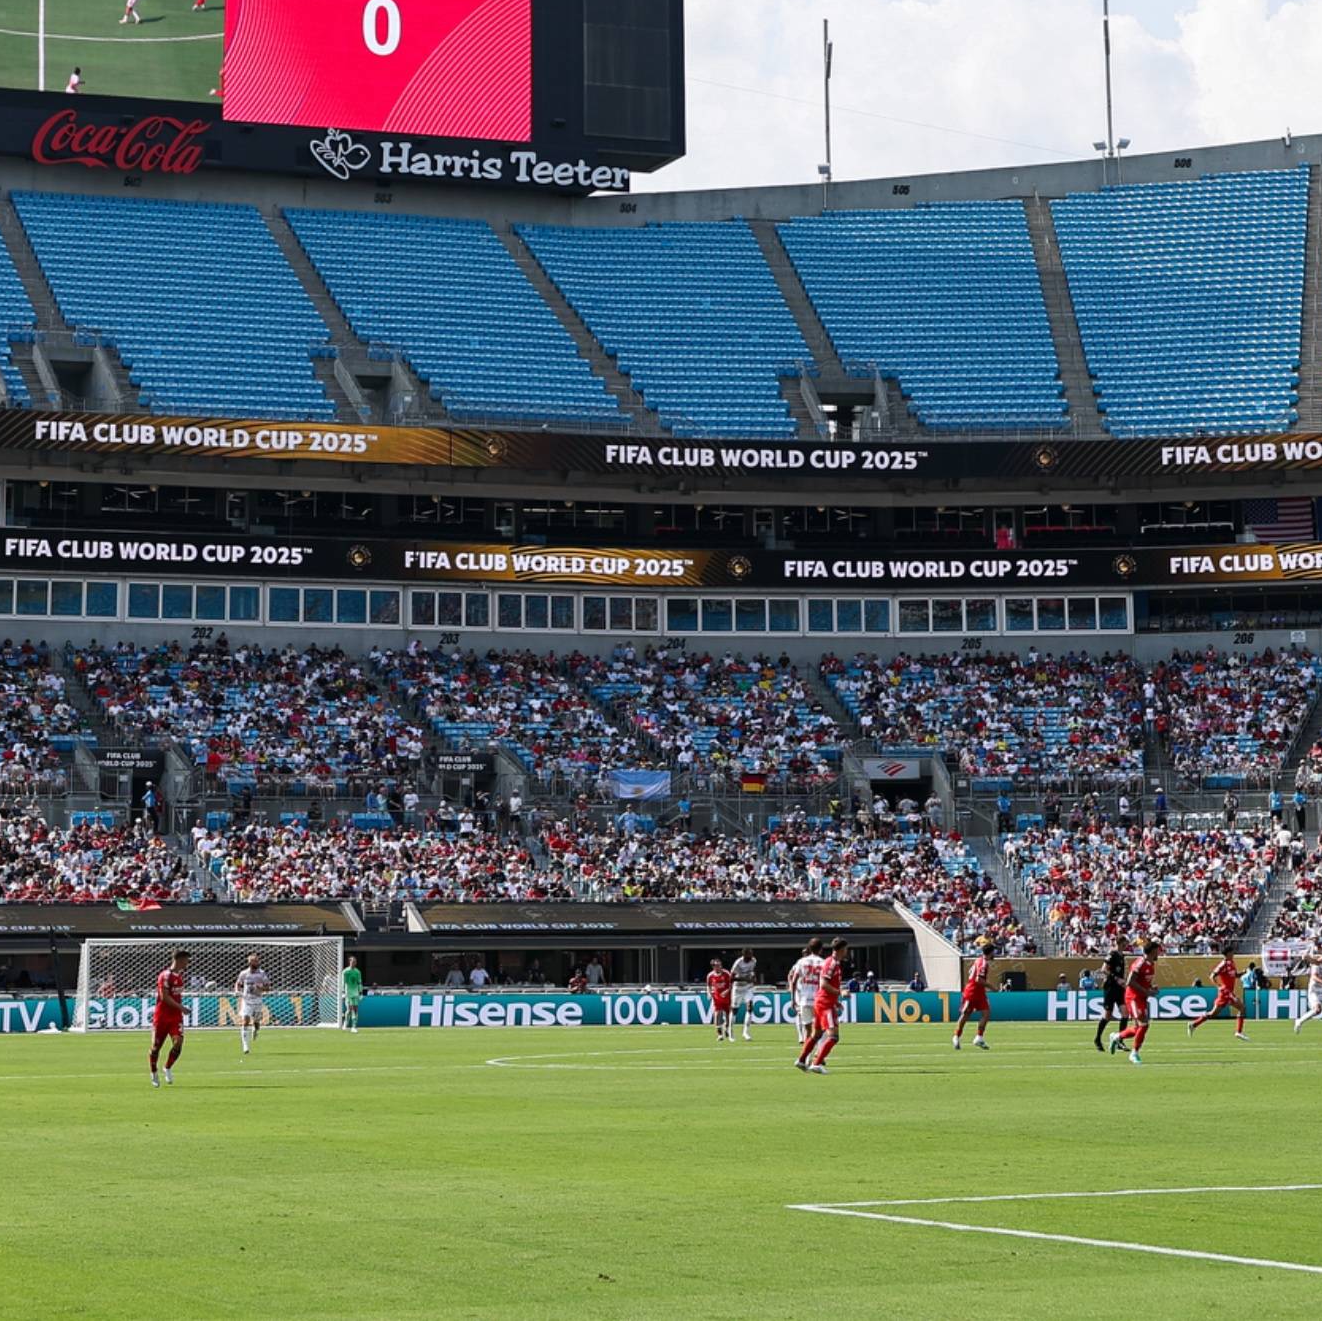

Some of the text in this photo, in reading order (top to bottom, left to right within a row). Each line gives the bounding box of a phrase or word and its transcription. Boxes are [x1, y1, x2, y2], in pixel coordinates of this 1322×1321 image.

[379, 141, 630, 189] Harris Teeter
[35, 421, 87, 443] FIFA
[93, 423, 155, 445] CLUB
[162, 426, 249, 448] WORLD
[255, 430, 302, 450] CUP
[606, 445, 653, 465] FIFA
[658, 447, 715, 466] CLUB
[721, 449, 804, 469] WORLD
[810, 450, 855, 469] CUP
[1161, 445, 1211, 465] FIFA
[1216, 443, 1276, 463] CLUB
[5, 539, 52, 558] FIFA
[57, 540, 113, 559] CLUB
[119, 542, 197, 562] WORLD
[203, 545, 245, 563] CUP
[405, 551, 450, 569] FIFA
[456, 553, 507, 571] CLUB
[513, 554, 584, 573] WORLD
[590, 557, 630, 574] CUP
[784, 560, 827, 578] FIFA
[833, 560, 884, 578] CLUB
[889, 561, 964, 578] WORLD
[969, 561, 1011, 577] CUP
[1170, 556, 1215, 574] FIFA
[1219, 554, 1274, 573] CLUB
[192, 627, 214, 639] 202
[440, 633, 459, 645] 203
[961, 638, 982, 650] 205
[1234, 633, 1254, 644] 206
[409, 996, 582, 1026] Hisense
[874, 993, 949, 1022] No. 1
